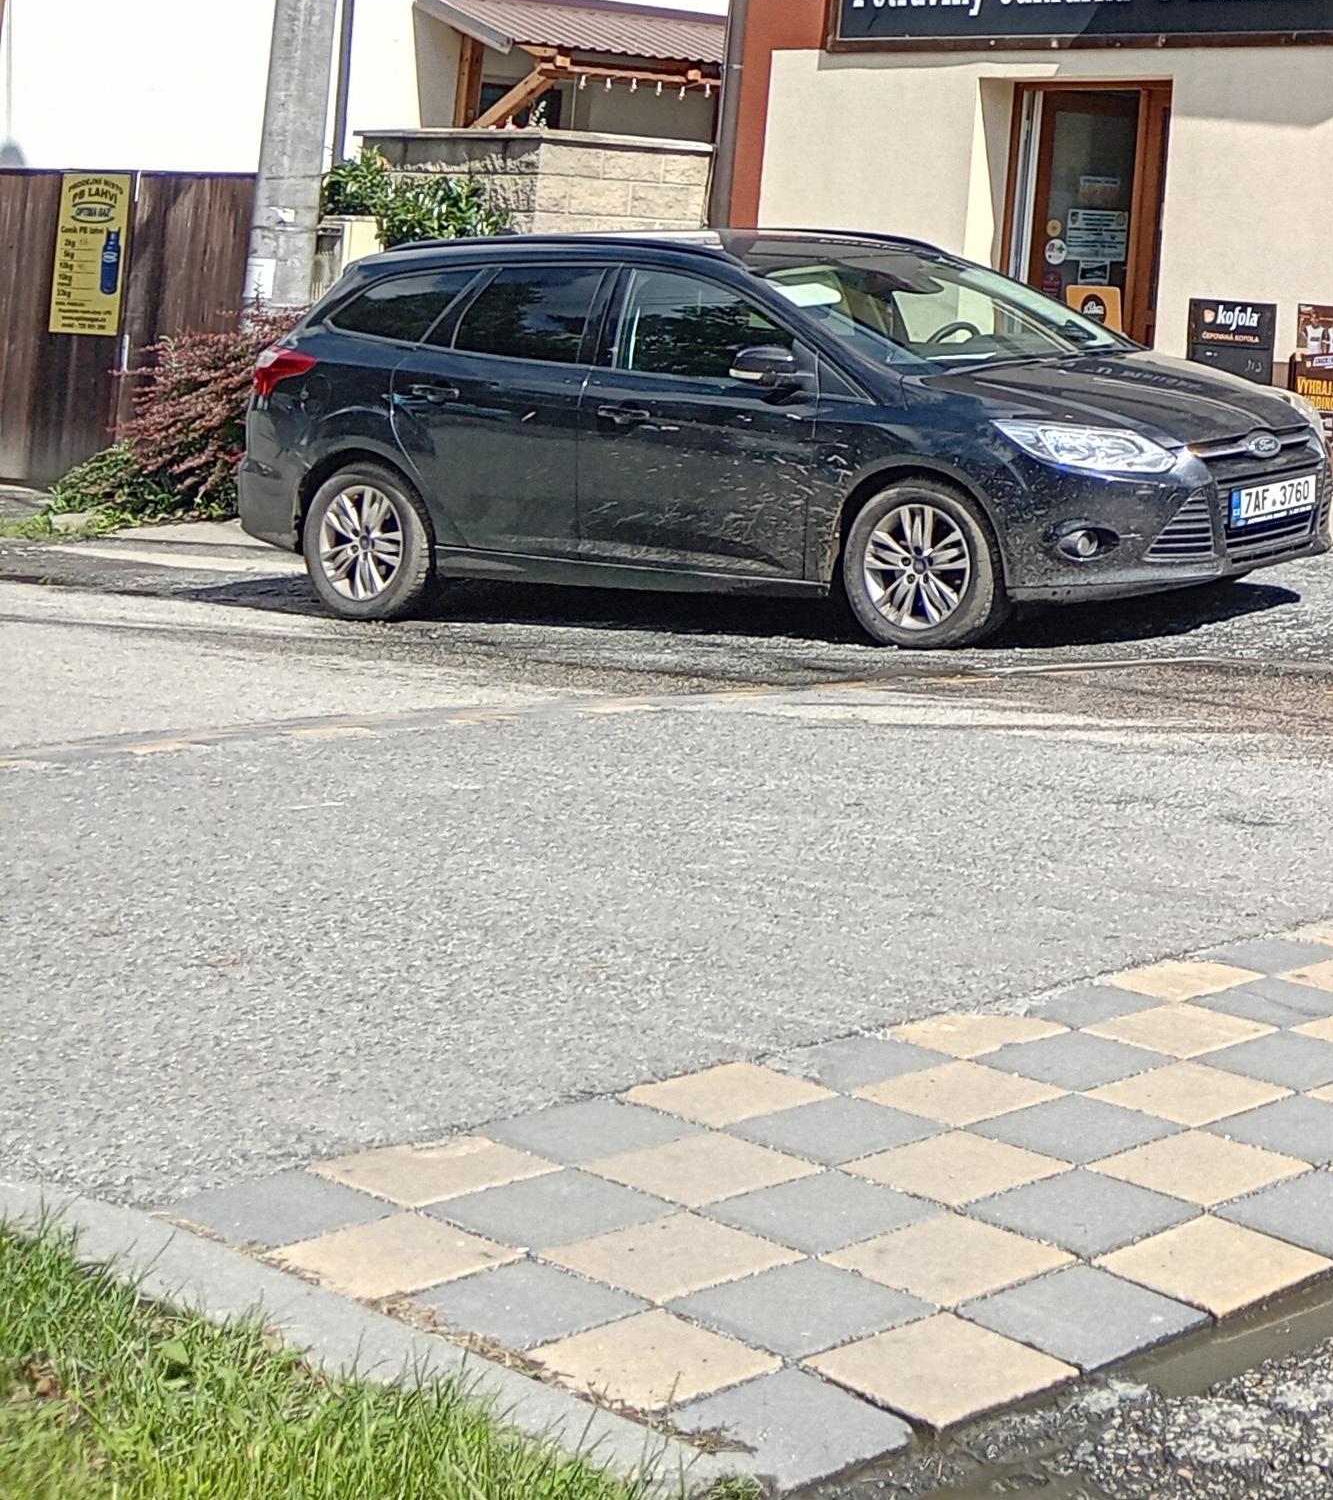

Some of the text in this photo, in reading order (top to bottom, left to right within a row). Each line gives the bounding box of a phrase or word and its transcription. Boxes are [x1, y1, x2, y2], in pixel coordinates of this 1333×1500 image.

[72, 189, 86, 202] PB
[1216, 304, 1261, 331] kofola
[1297, 376, 1333, 396] VYHRAJ
[1244, 488, 1270, 514] 7AF
[1279, 480, 1310, 506] 3760
